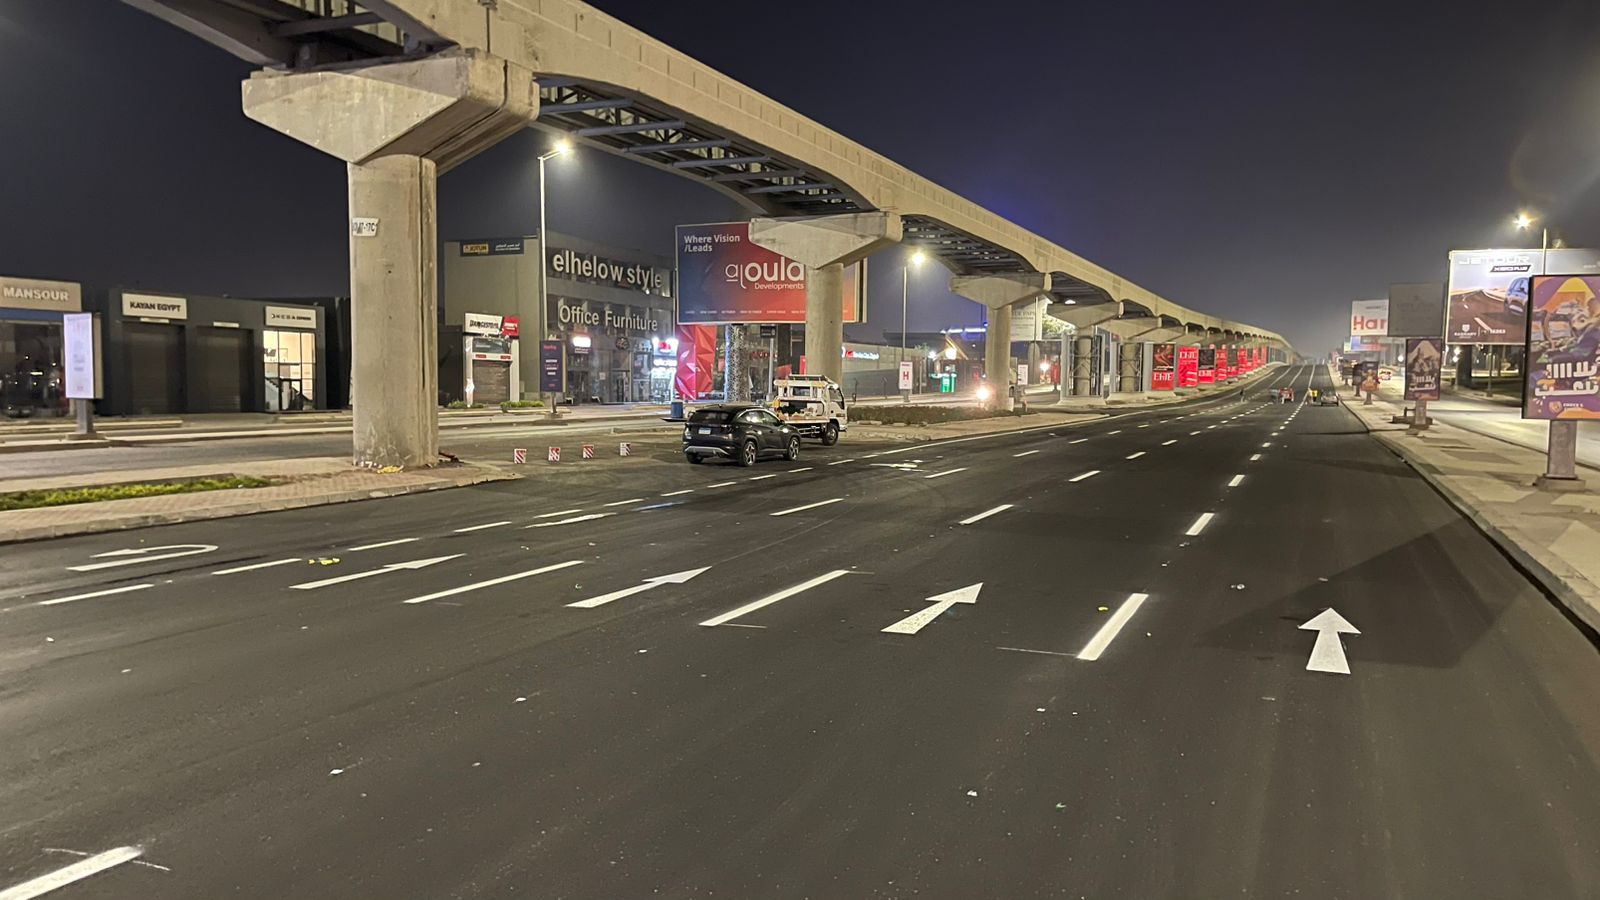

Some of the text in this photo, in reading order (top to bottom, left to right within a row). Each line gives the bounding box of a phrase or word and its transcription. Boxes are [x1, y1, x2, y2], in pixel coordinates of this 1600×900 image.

[684, 234, 740, 243] Where Vision
[684, 244, 713, 252] /Leads
[553, 250, 662, 290] elhelow style
[754, 282, 804, 291] Developments
[3, 287, 69, 301] MANSOUR
[130, 301, 181, 312] KAYAN EGYPT
[559, 305, 658, 331] Office Furniture
